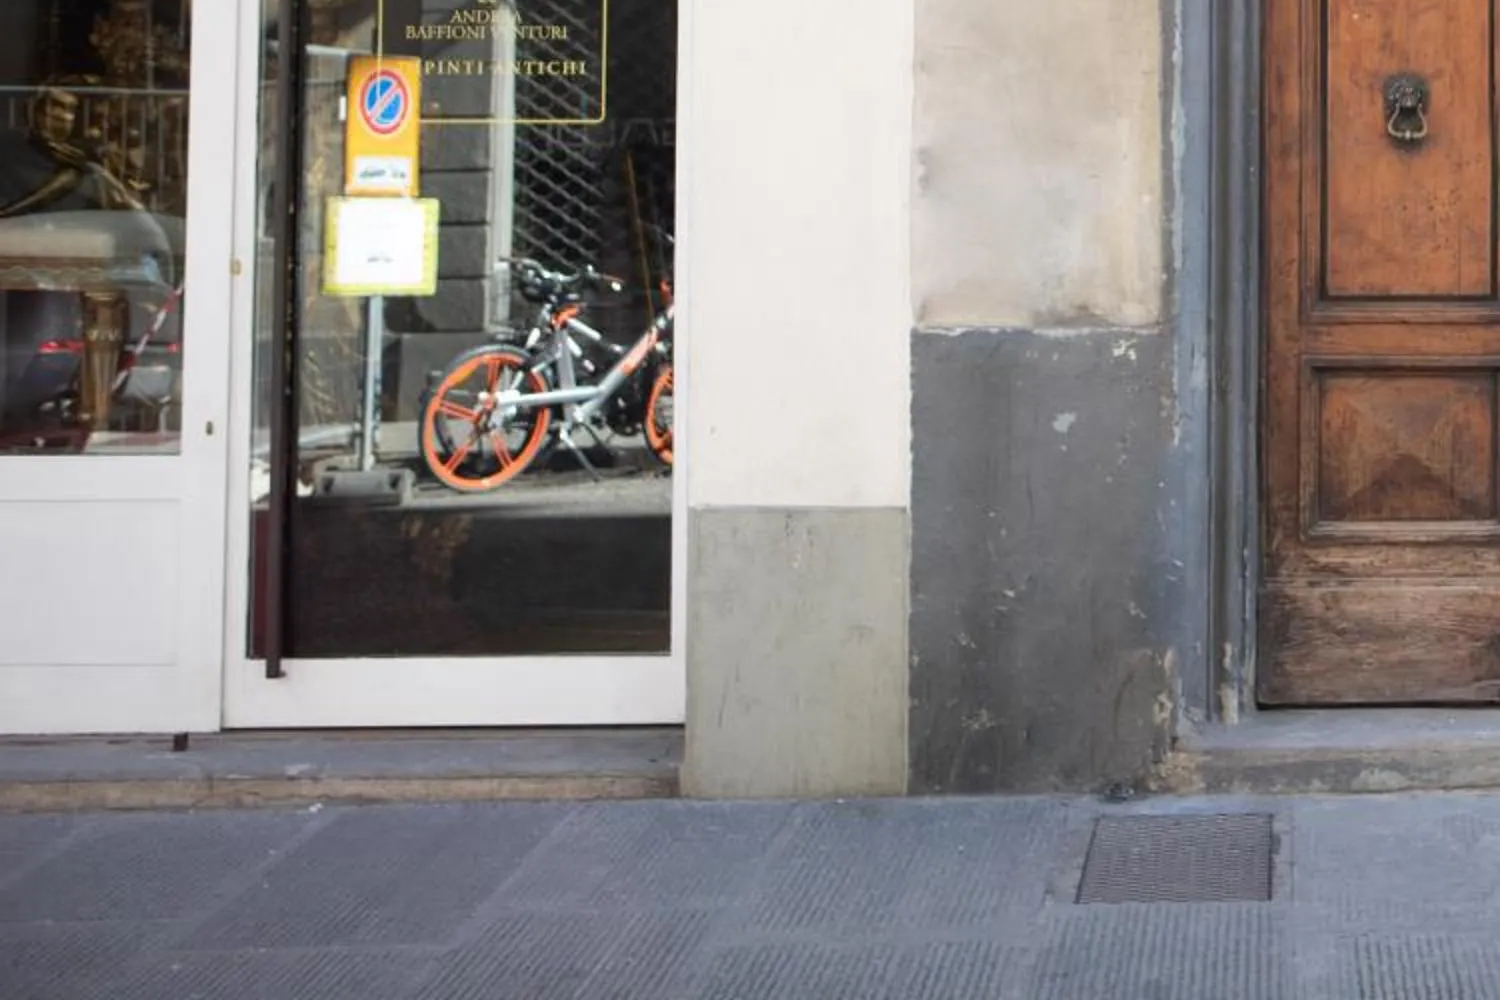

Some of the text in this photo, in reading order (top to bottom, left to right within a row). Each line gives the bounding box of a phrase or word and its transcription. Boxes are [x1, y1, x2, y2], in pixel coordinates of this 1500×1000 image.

[450, 10, 522, 25] ANDA
[405, 25, 568, 40] BAFFIONI VNTURI
